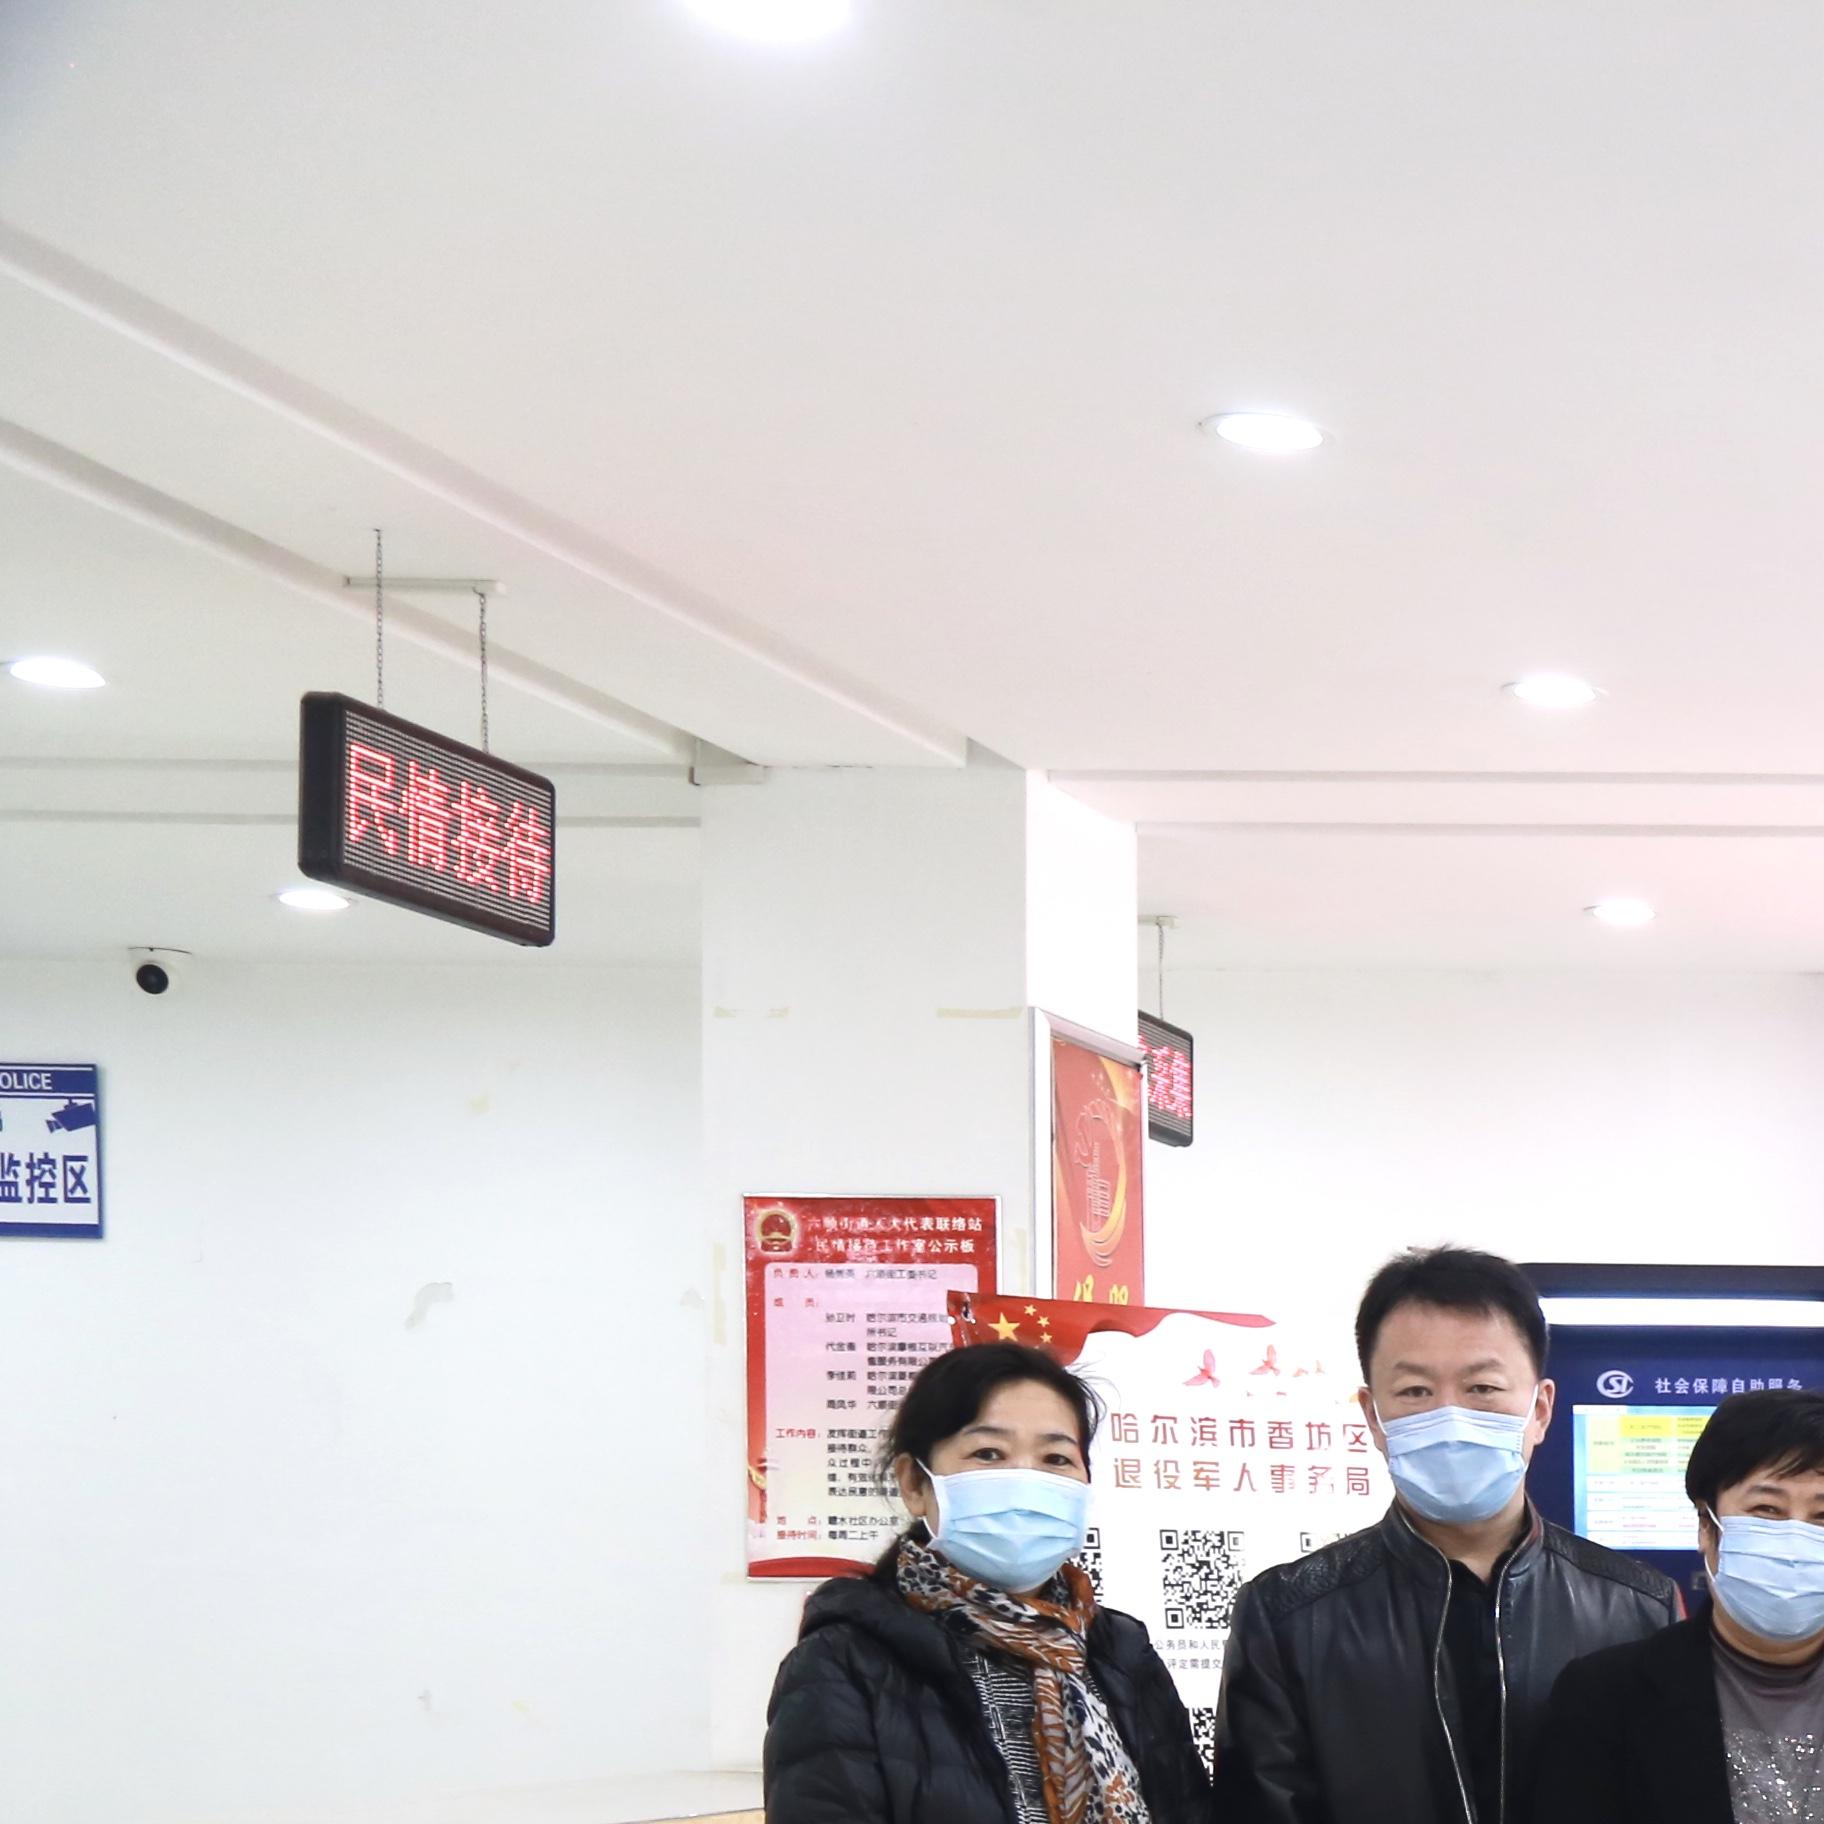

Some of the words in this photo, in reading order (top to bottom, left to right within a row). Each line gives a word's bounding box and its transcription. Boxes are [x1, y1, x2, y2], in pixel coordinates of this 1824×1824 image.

[349, 740, 552, 904] 民情接待
[1110, 1412, 1368, 1453] 哈尔滨市香坊区
[1112, 1457, 1371, 1497] 退役军人事务局
